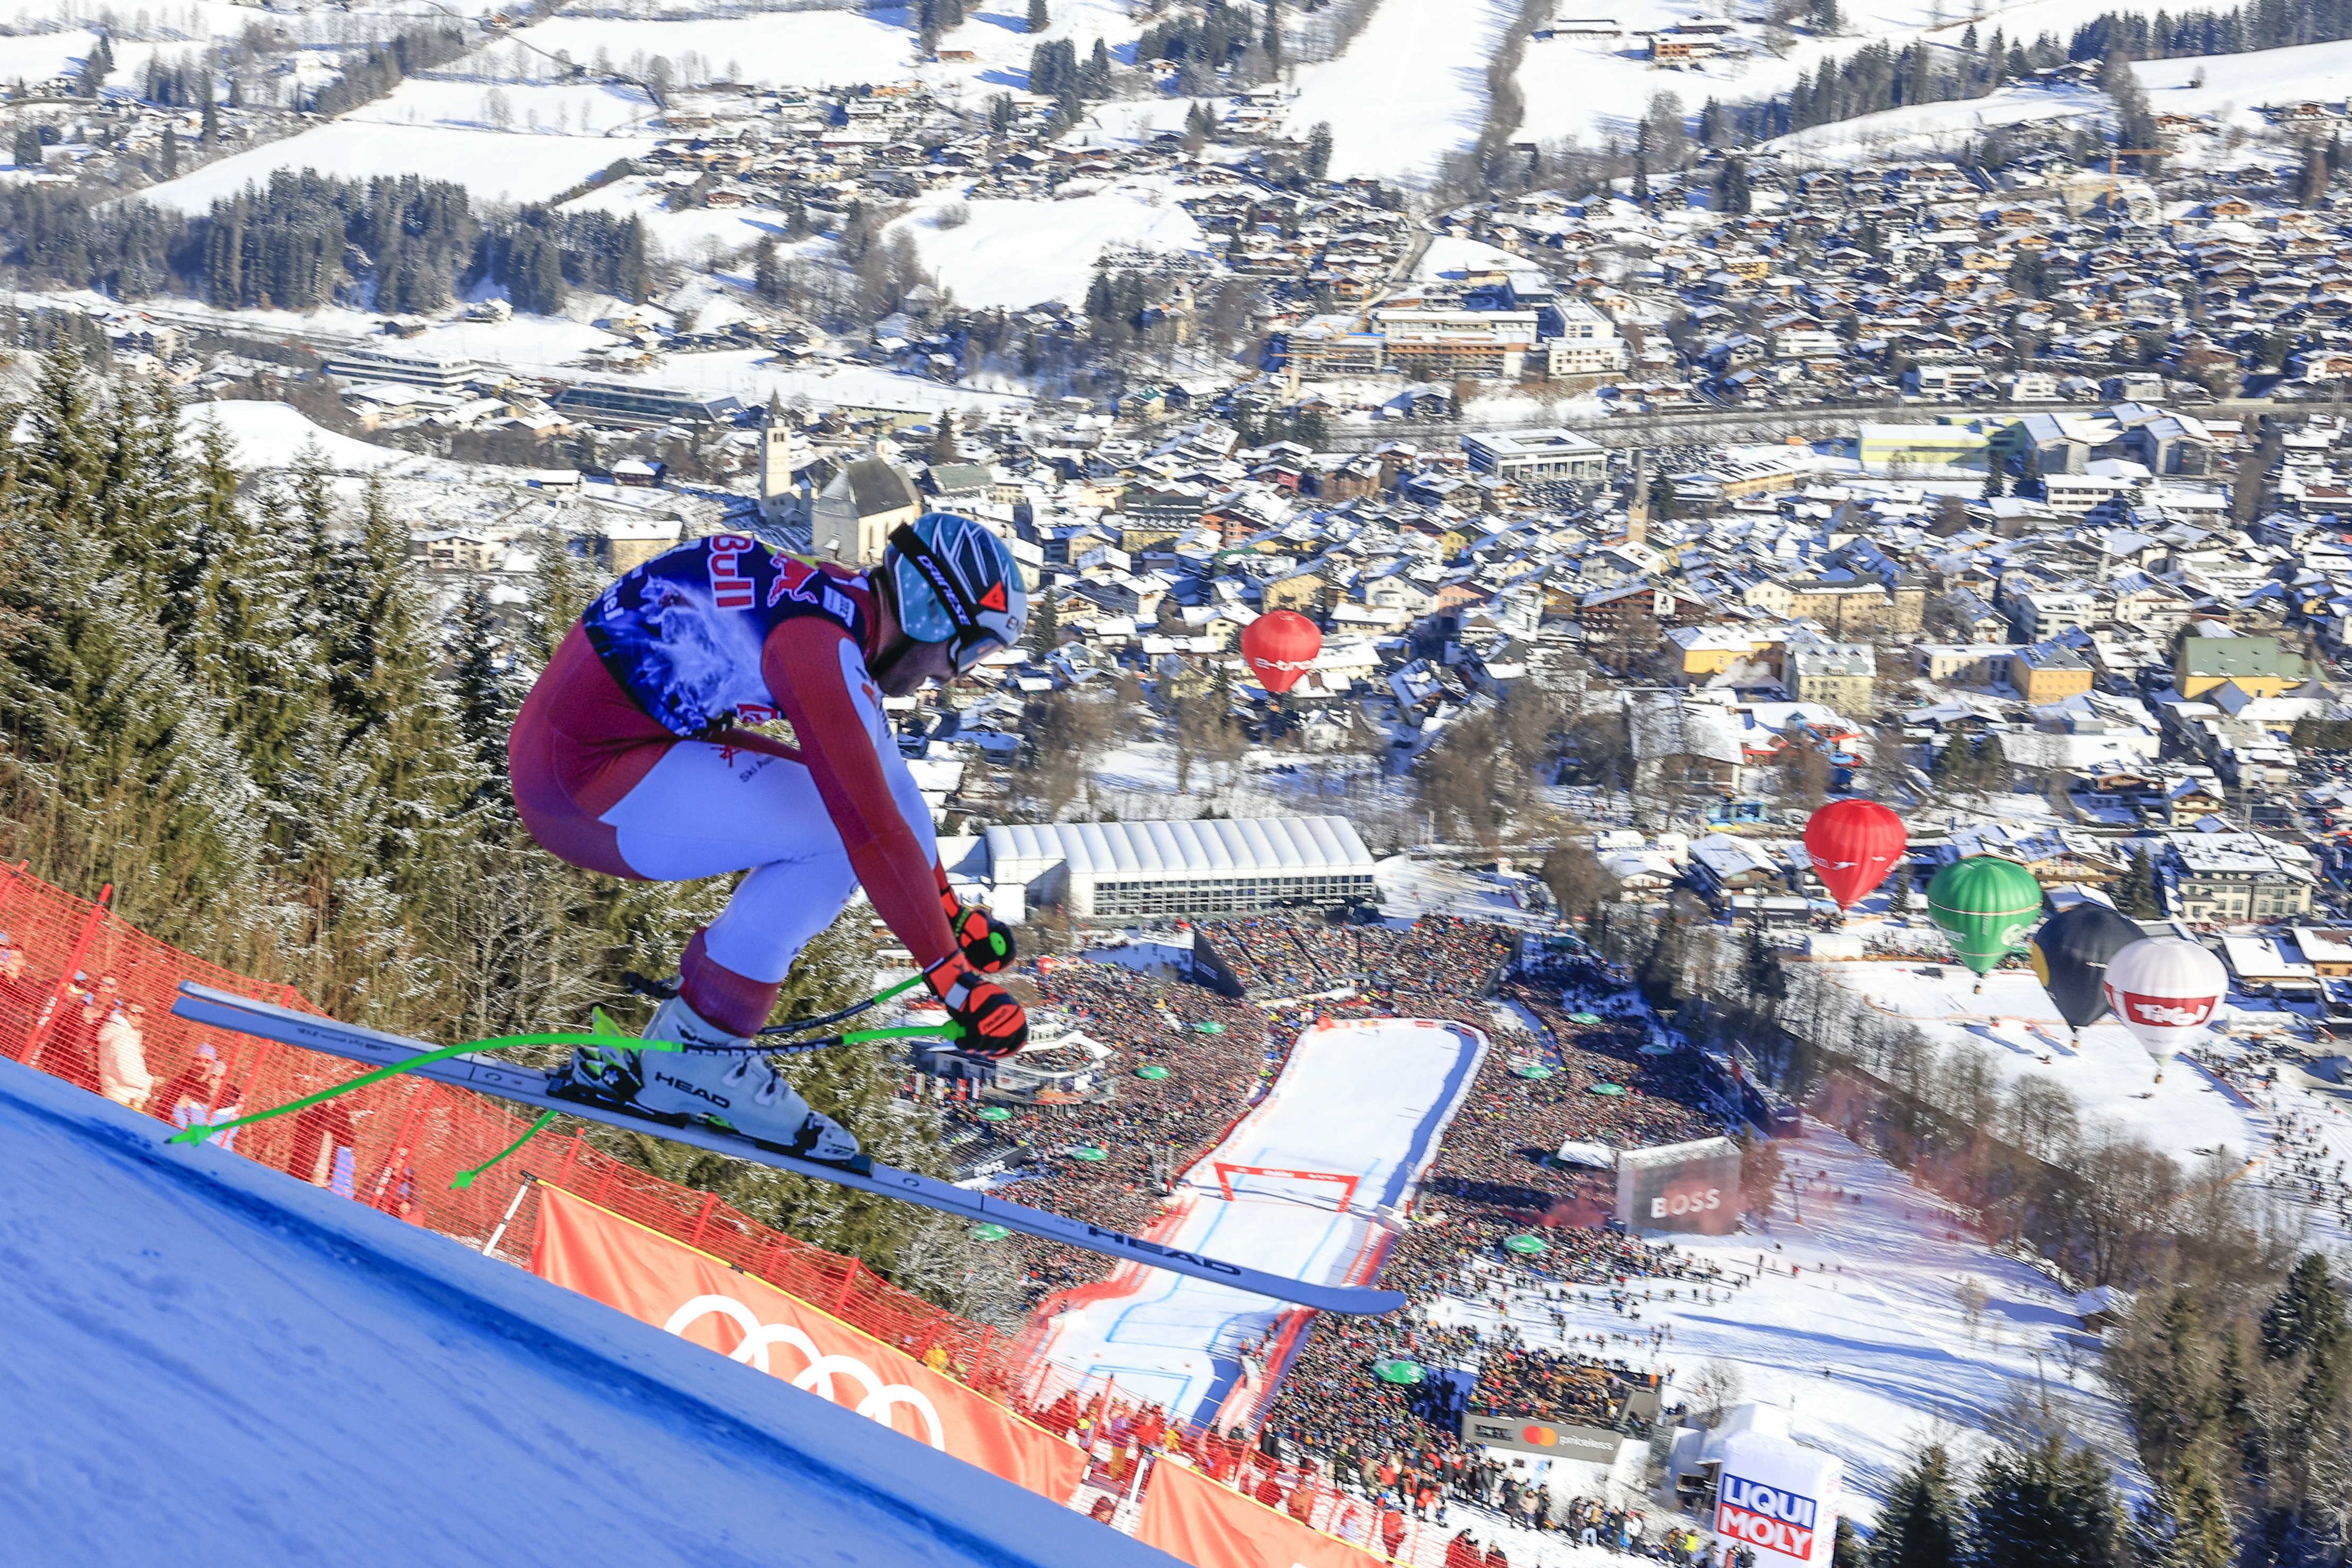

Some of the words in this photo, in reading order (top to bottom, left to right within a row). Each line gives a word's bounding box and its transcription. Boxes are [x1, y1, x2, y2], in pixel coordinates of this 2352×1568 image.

[707, 534, 755, 610] Bull
[654, 1071, 730, 1109] HEAD
[1650, 1188, 1720, 1219] BOSS
[1089, 1225, 1241, 1275] HEAD
[1559, 1434, 1614, 1450] priceless
[1722, 1475, 1816, 1529] LIQUI
[1719, 1506, 1811, 1558] MOLY
